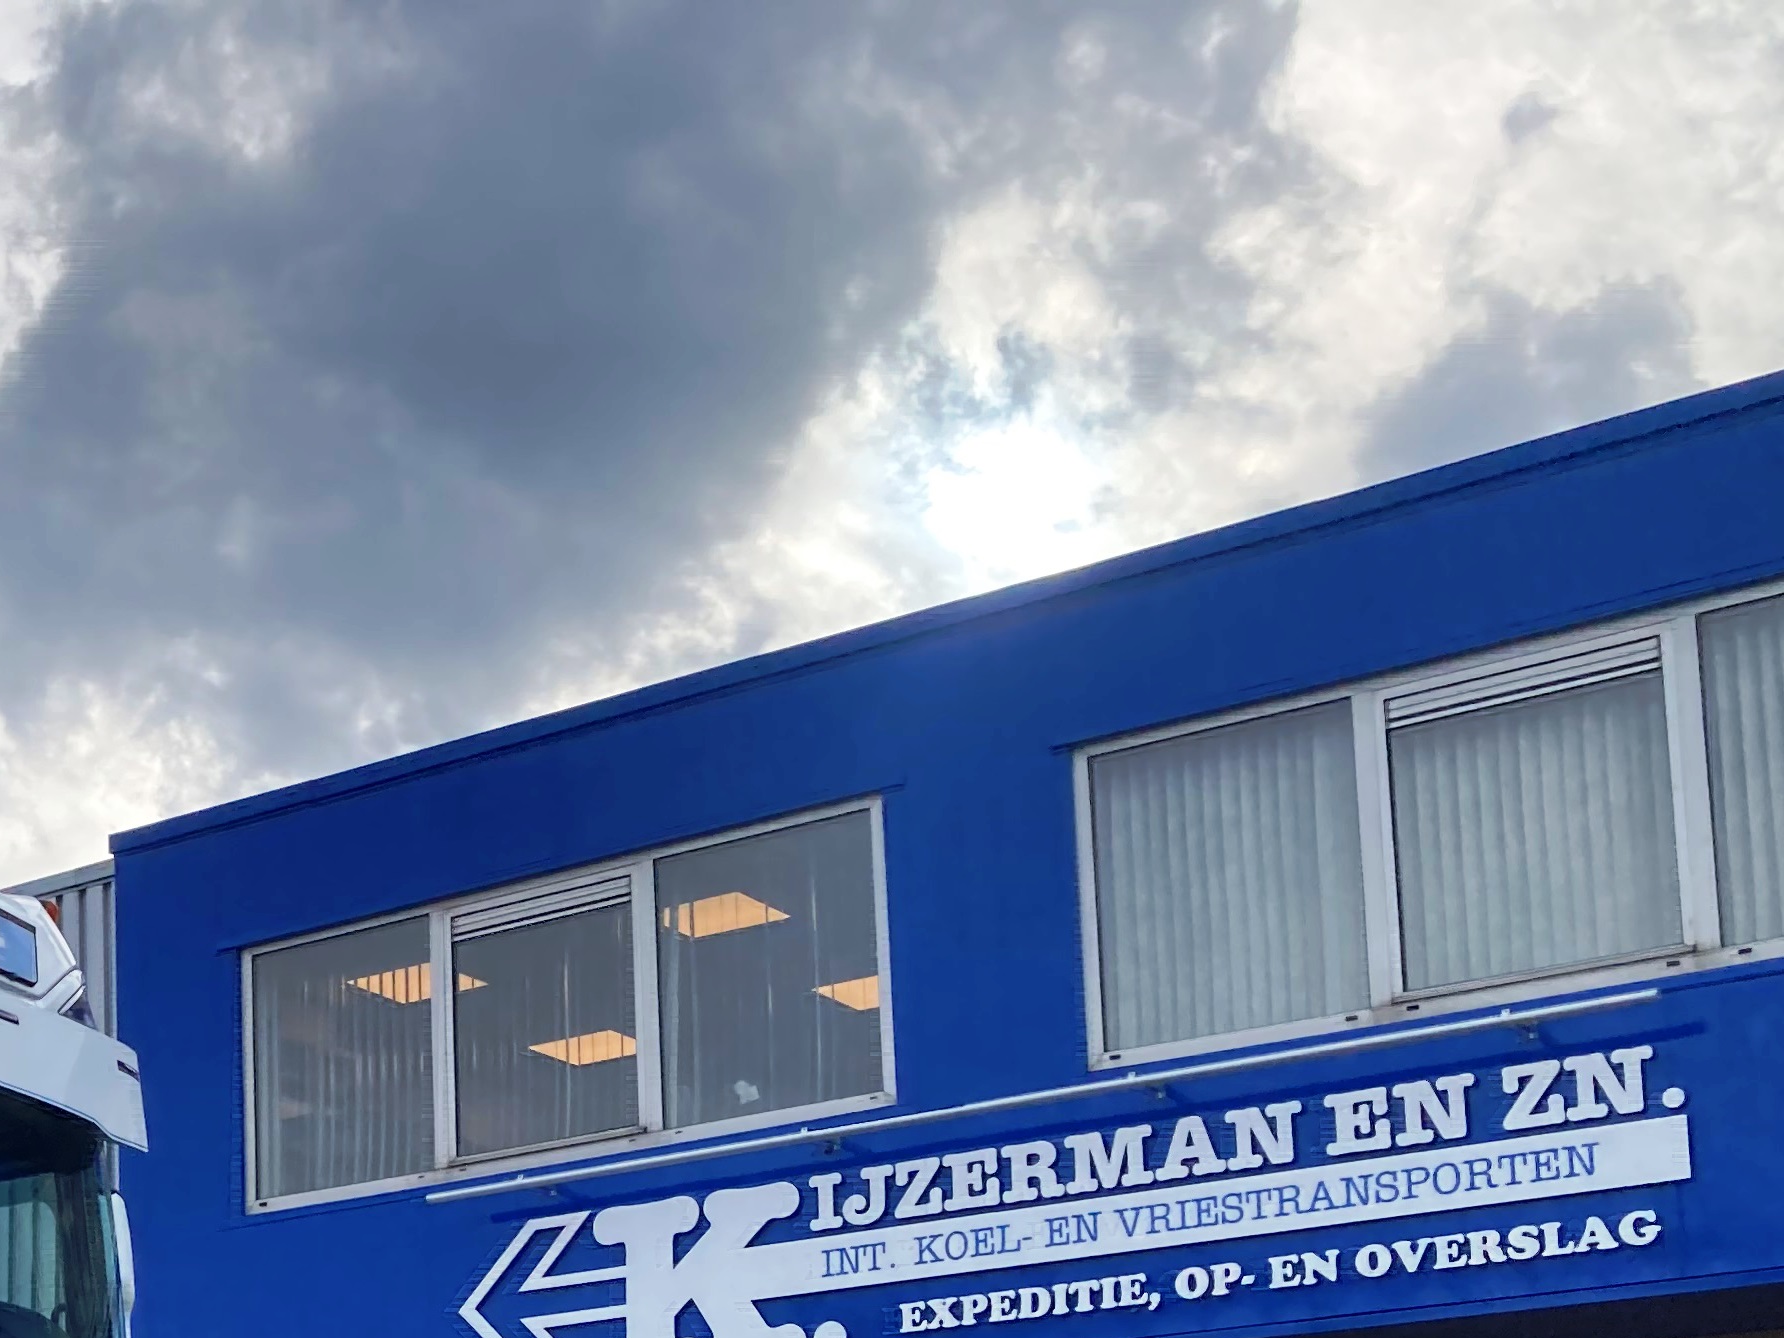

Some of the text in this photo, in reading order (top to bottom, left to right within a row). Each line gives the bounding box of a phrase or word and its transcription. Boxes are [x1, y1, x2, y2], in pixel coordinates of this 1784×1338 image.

[808, 1100, 1302, 1233] IJZERMAN
[1323, 1072, 1476, 1157] EN
[1500, 1045, 1686, 1131] ZN.
[820, 1142, 1600, 1280] INT. KOEL- EN VRIESTRANSPORTEN
[899, 1209, 1662, 1334] EXPEDITIE, OP- EN OVERSLAG
